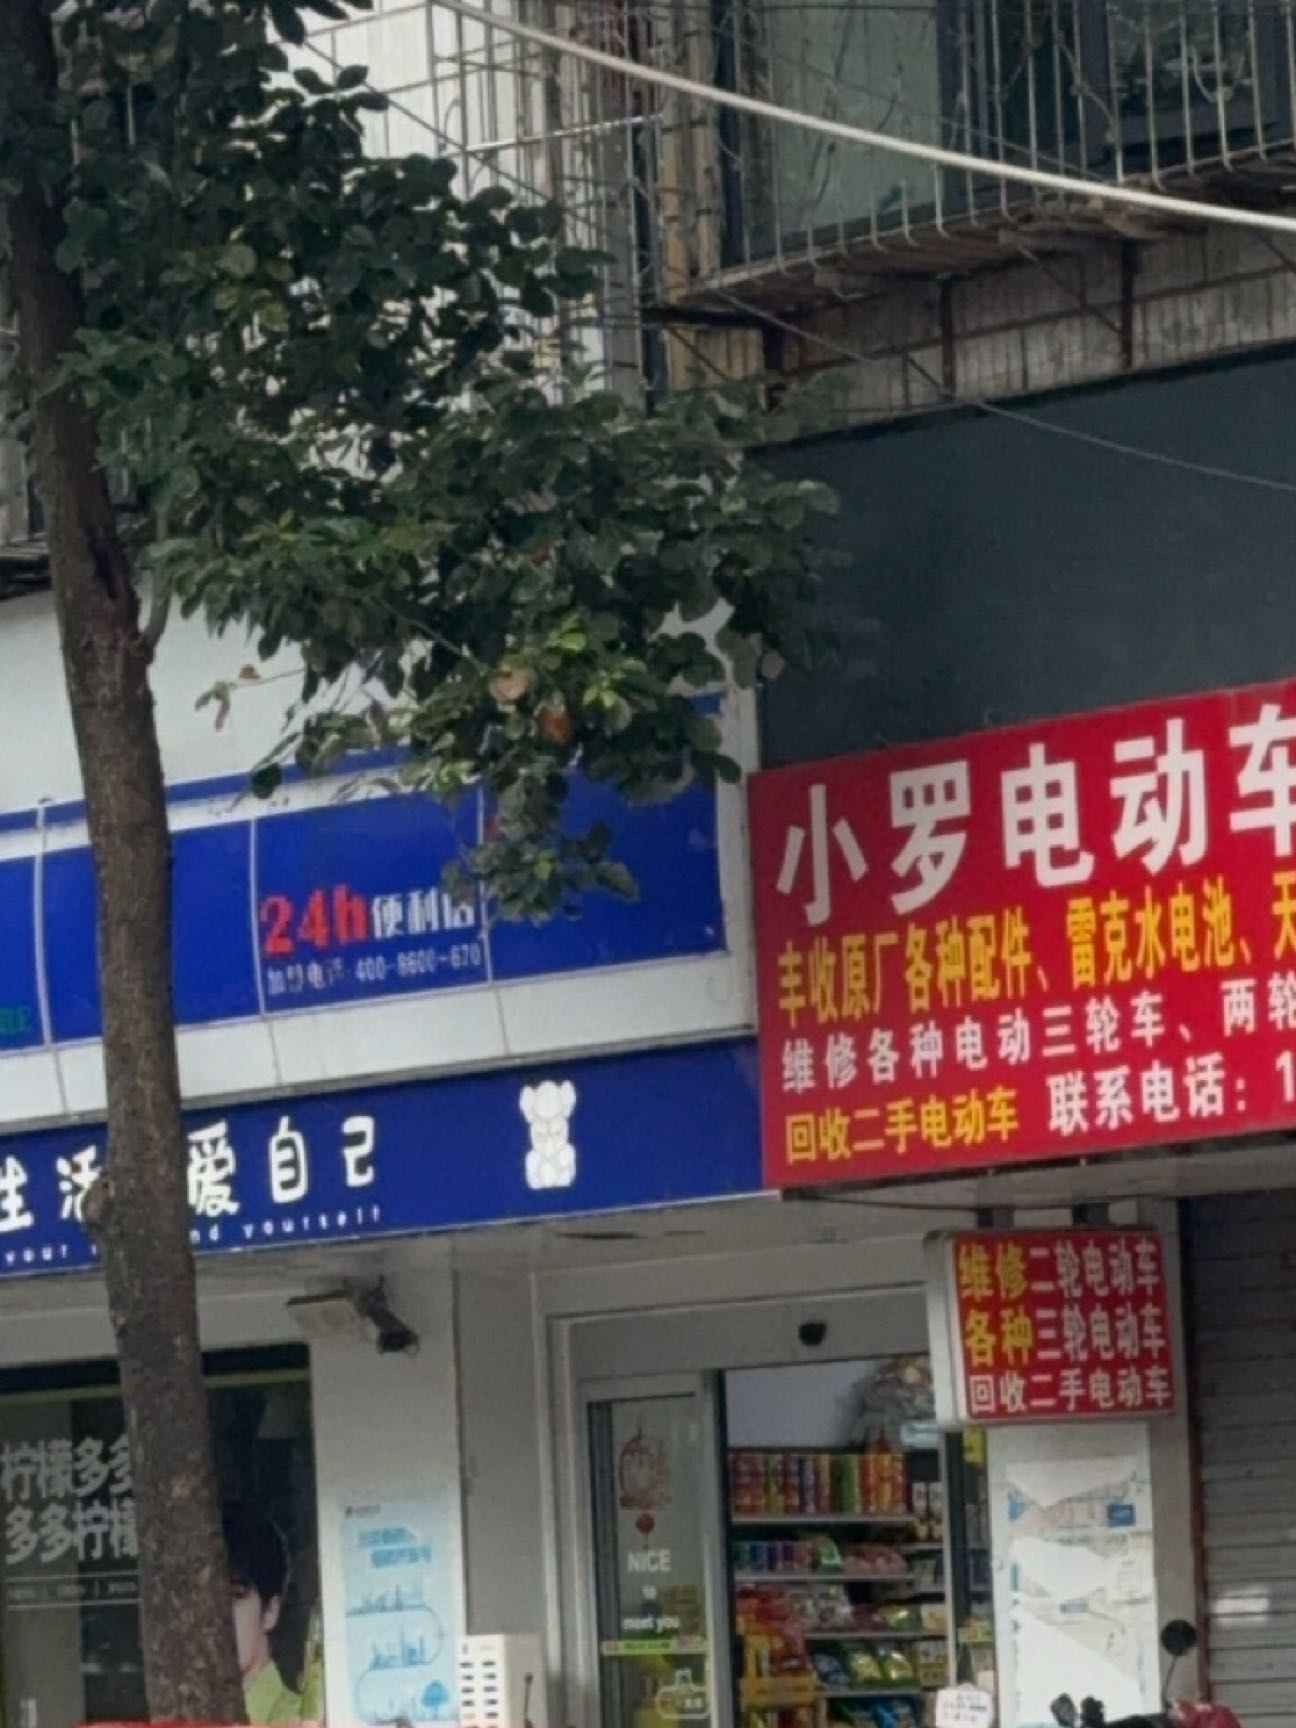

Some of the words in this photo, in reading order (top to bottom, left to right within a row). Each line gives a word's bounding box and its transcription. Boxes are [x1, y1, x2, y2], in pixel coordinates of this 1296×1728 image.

[785, 1086, 1018, 1165] 回收二手电动车
[969, 1365, 1172, 1413] 回收二手电动车
[627, 1548, 672, 1573] NICE
